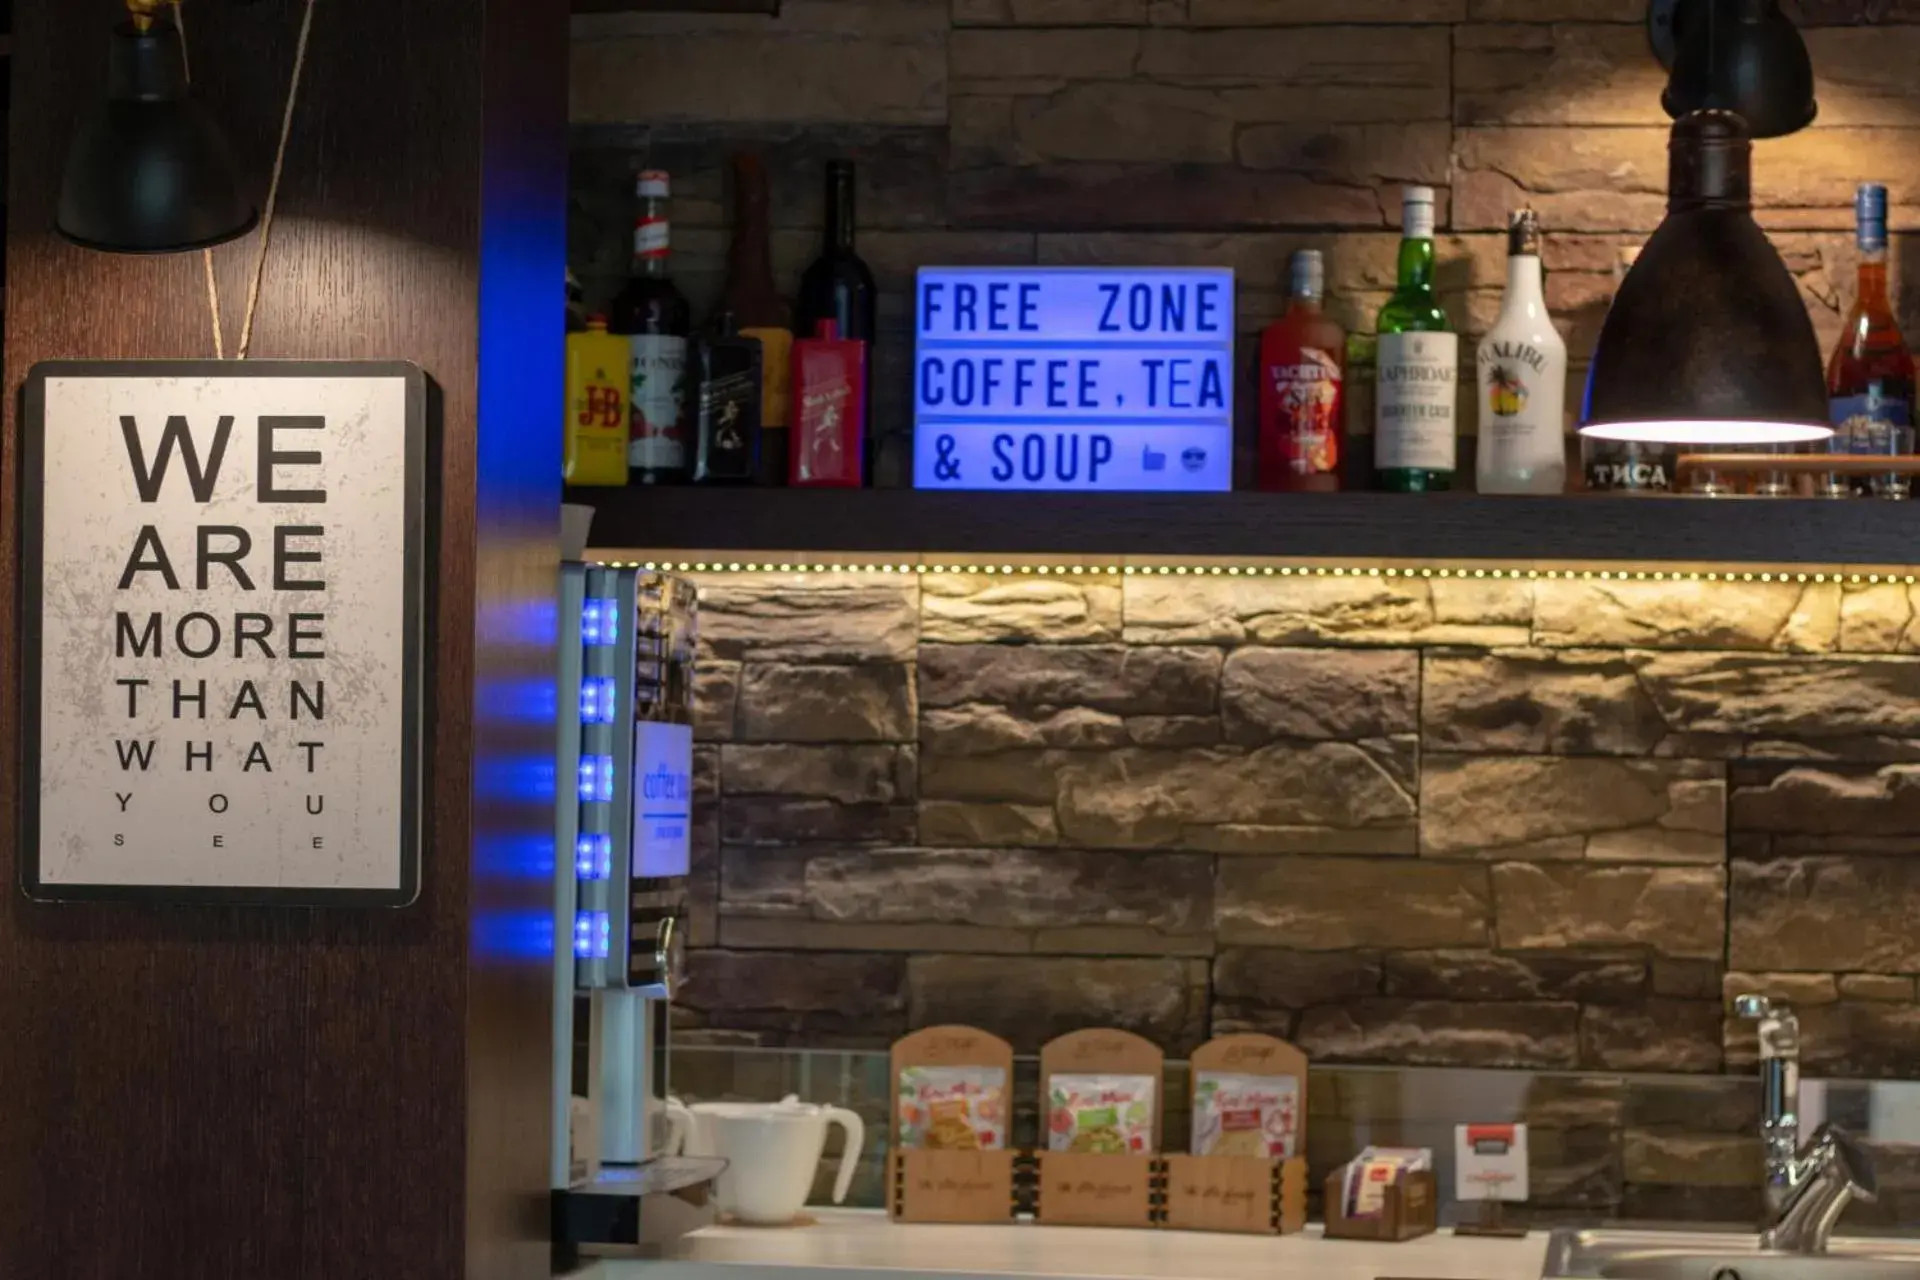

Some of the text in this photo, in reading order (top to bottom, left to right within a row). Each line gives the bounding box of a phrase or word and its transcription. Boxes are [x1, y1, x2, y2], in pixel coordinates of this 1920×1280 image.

[922, 282, 1219, 332] FREE ZONE
[1140, 358, 1225, 408] TEA
[118, 415, 327, 503] WE
[933, 433, 1113, 482] & SOUP
[116, 525, 327, 591] ARE
[115, 611, 326, 659] MORE
[116, 679, 324, 720] THAN
[115, 740, 324, 772] WHAT
[115, 792, 324, 815] YOU
[113, 833, 323, 849] SEE
